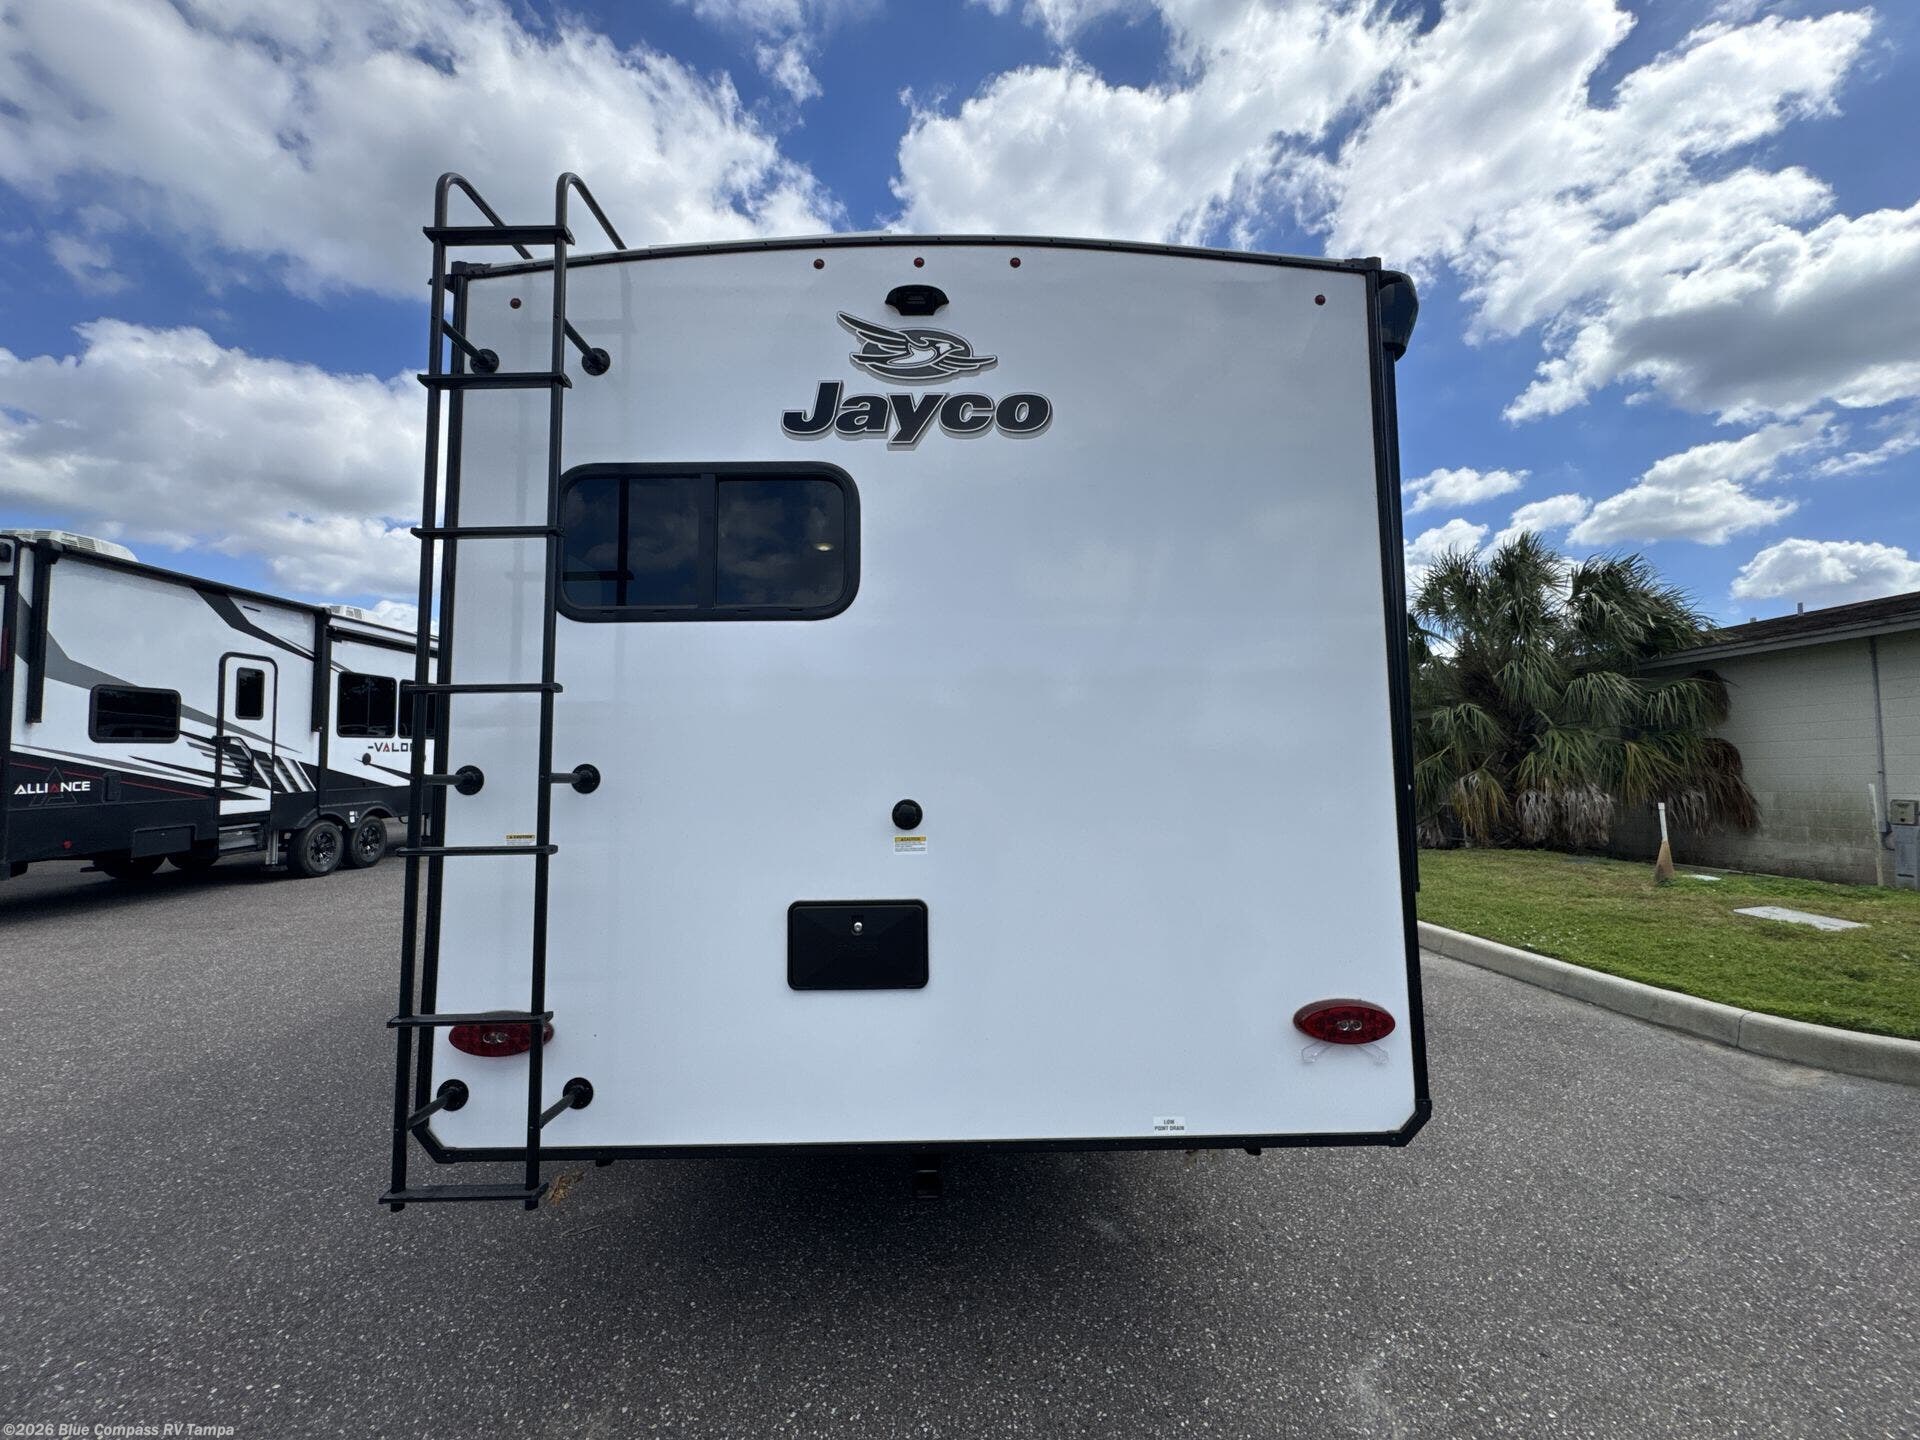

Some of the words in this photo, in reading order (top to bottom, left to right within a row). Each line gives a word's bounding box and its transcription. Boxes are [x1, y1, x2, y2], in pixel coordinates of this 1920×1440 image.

[782, 380, 1052, 447] Jayco
[374, 742, 412, 753] VALO
[14, 781, 91, 795] ALLIANCE
